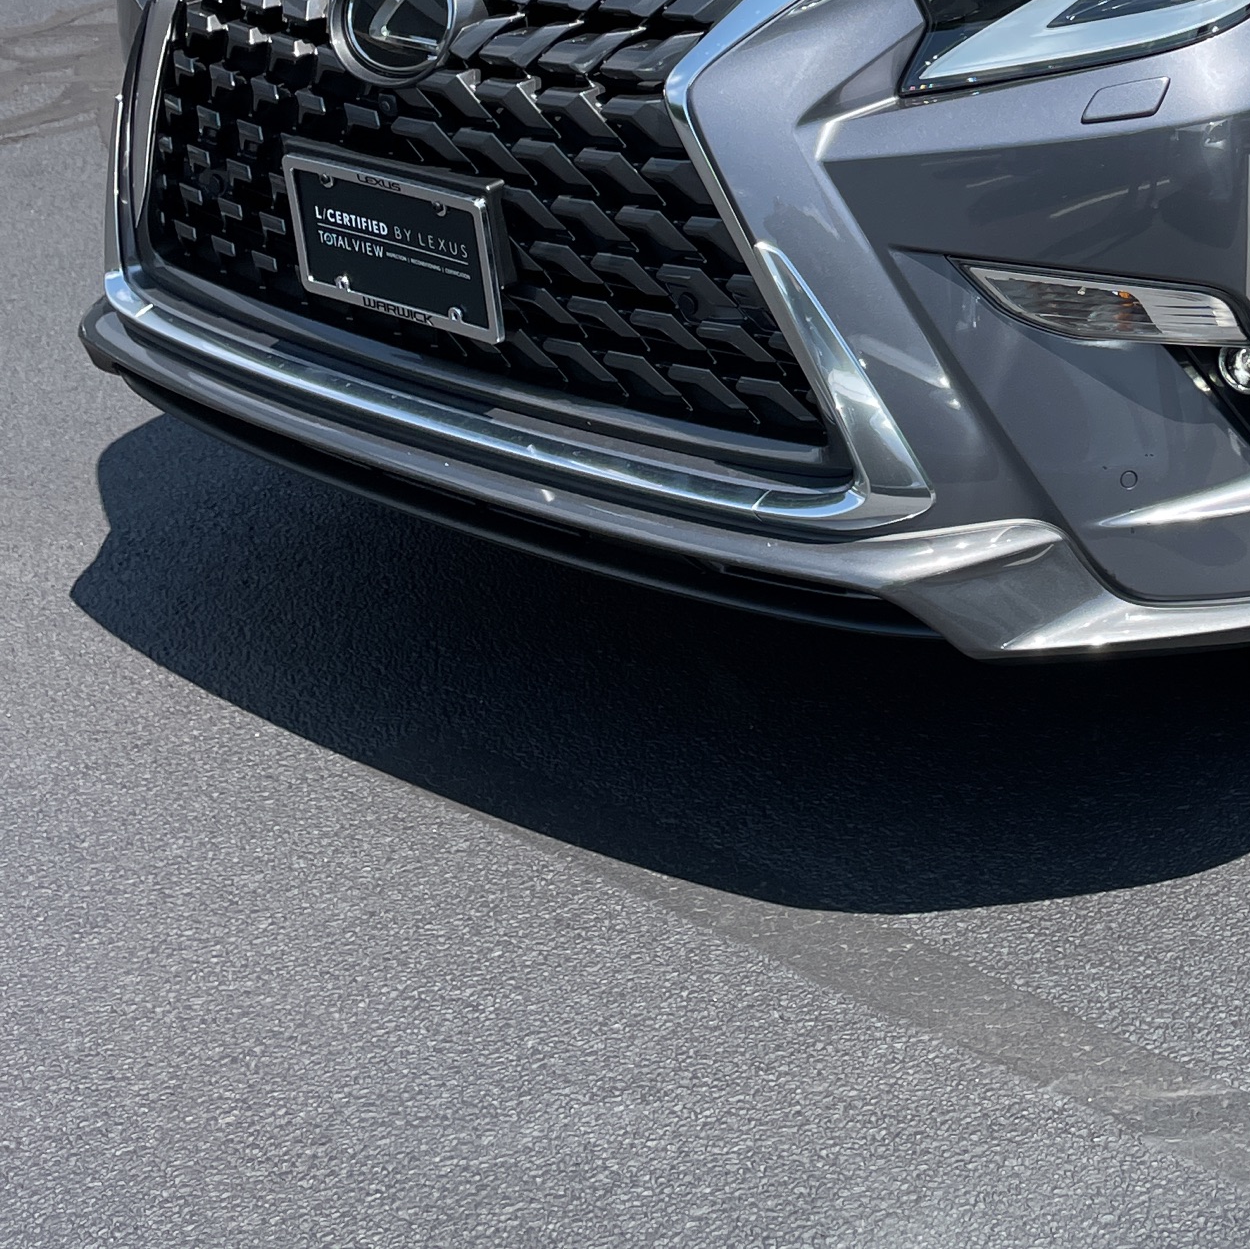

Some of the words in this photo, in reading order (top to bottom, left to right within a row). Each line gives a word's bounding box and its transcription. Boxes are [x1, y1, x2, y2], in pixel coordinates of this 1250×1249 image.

[356, 173, 402, 192] LEXUS
[393, 225, 411, 242] BY
[418, 232, 468, 258] LEXUS
[362, 296, 435, 327] WARWICK
